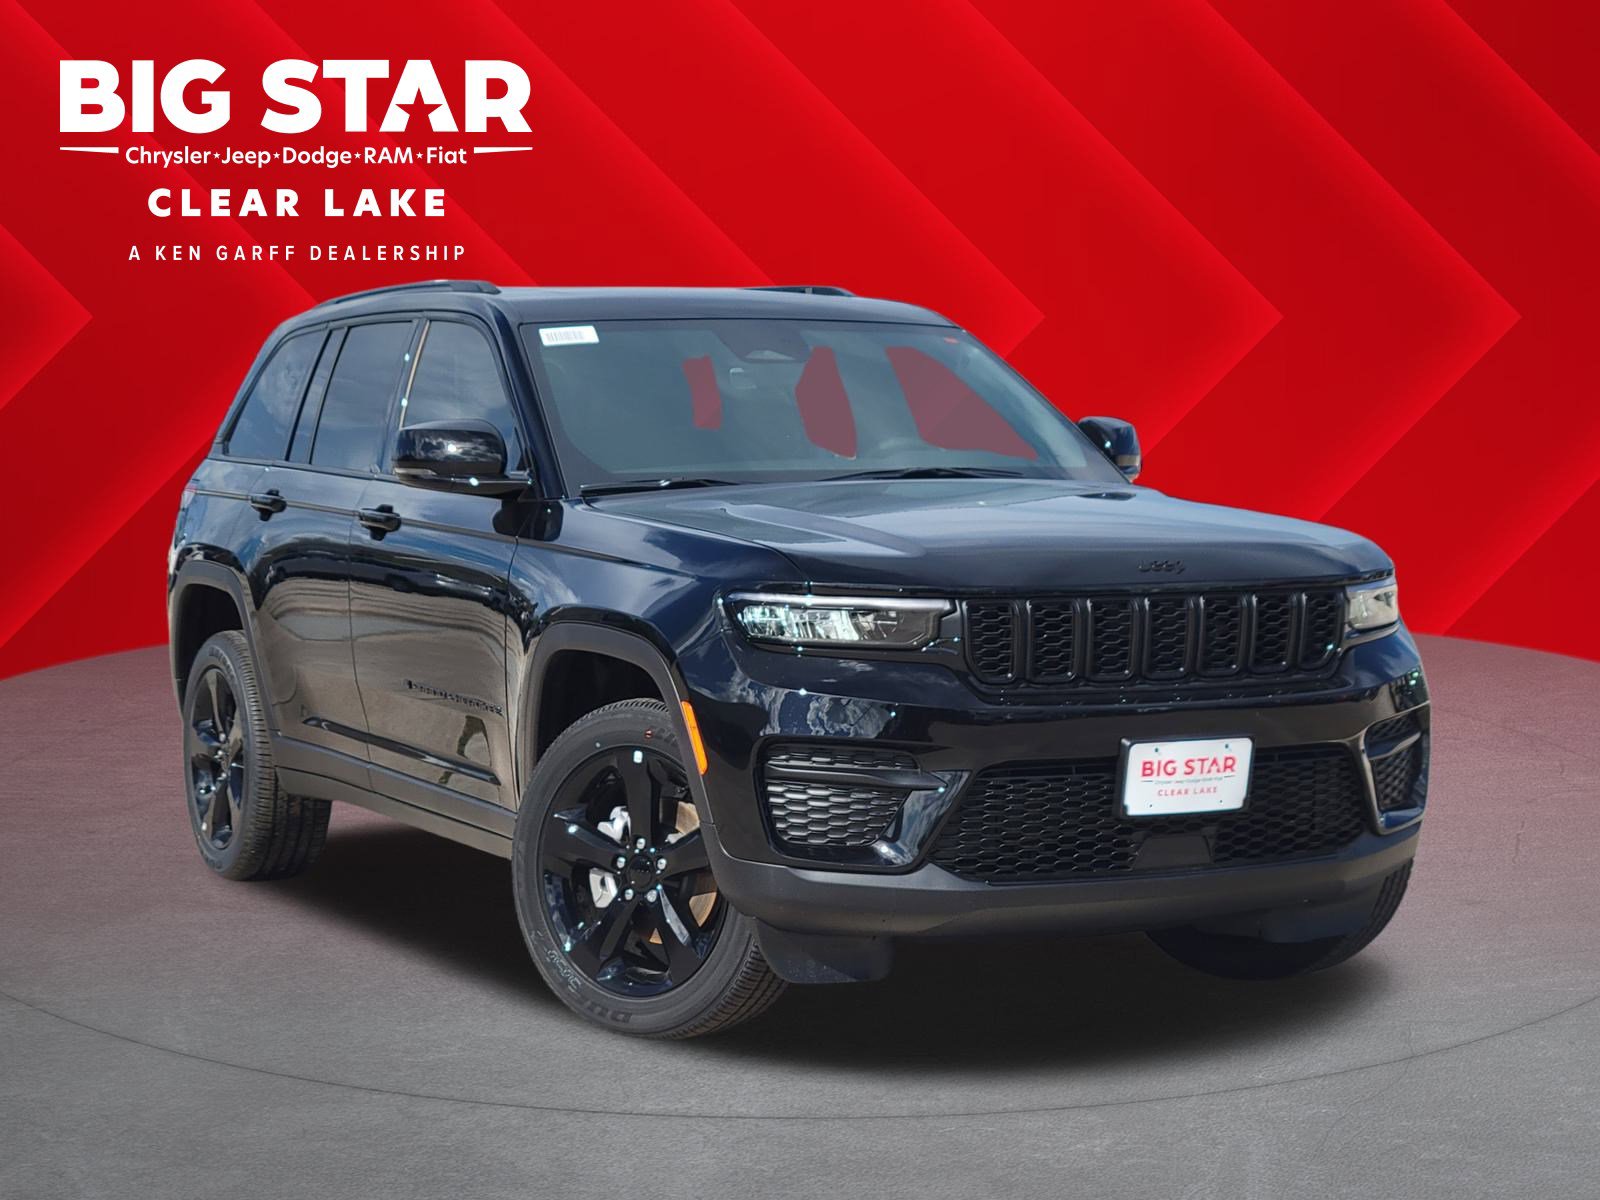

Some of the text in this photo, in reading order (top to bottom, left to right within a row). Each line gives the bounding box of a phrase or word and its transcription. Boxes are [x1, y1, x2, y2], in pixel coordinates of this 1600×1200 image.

[1141, 757, 1236, 777] BIG STAR
[1157, 786, 1218, 797] CLEAR LAKE
